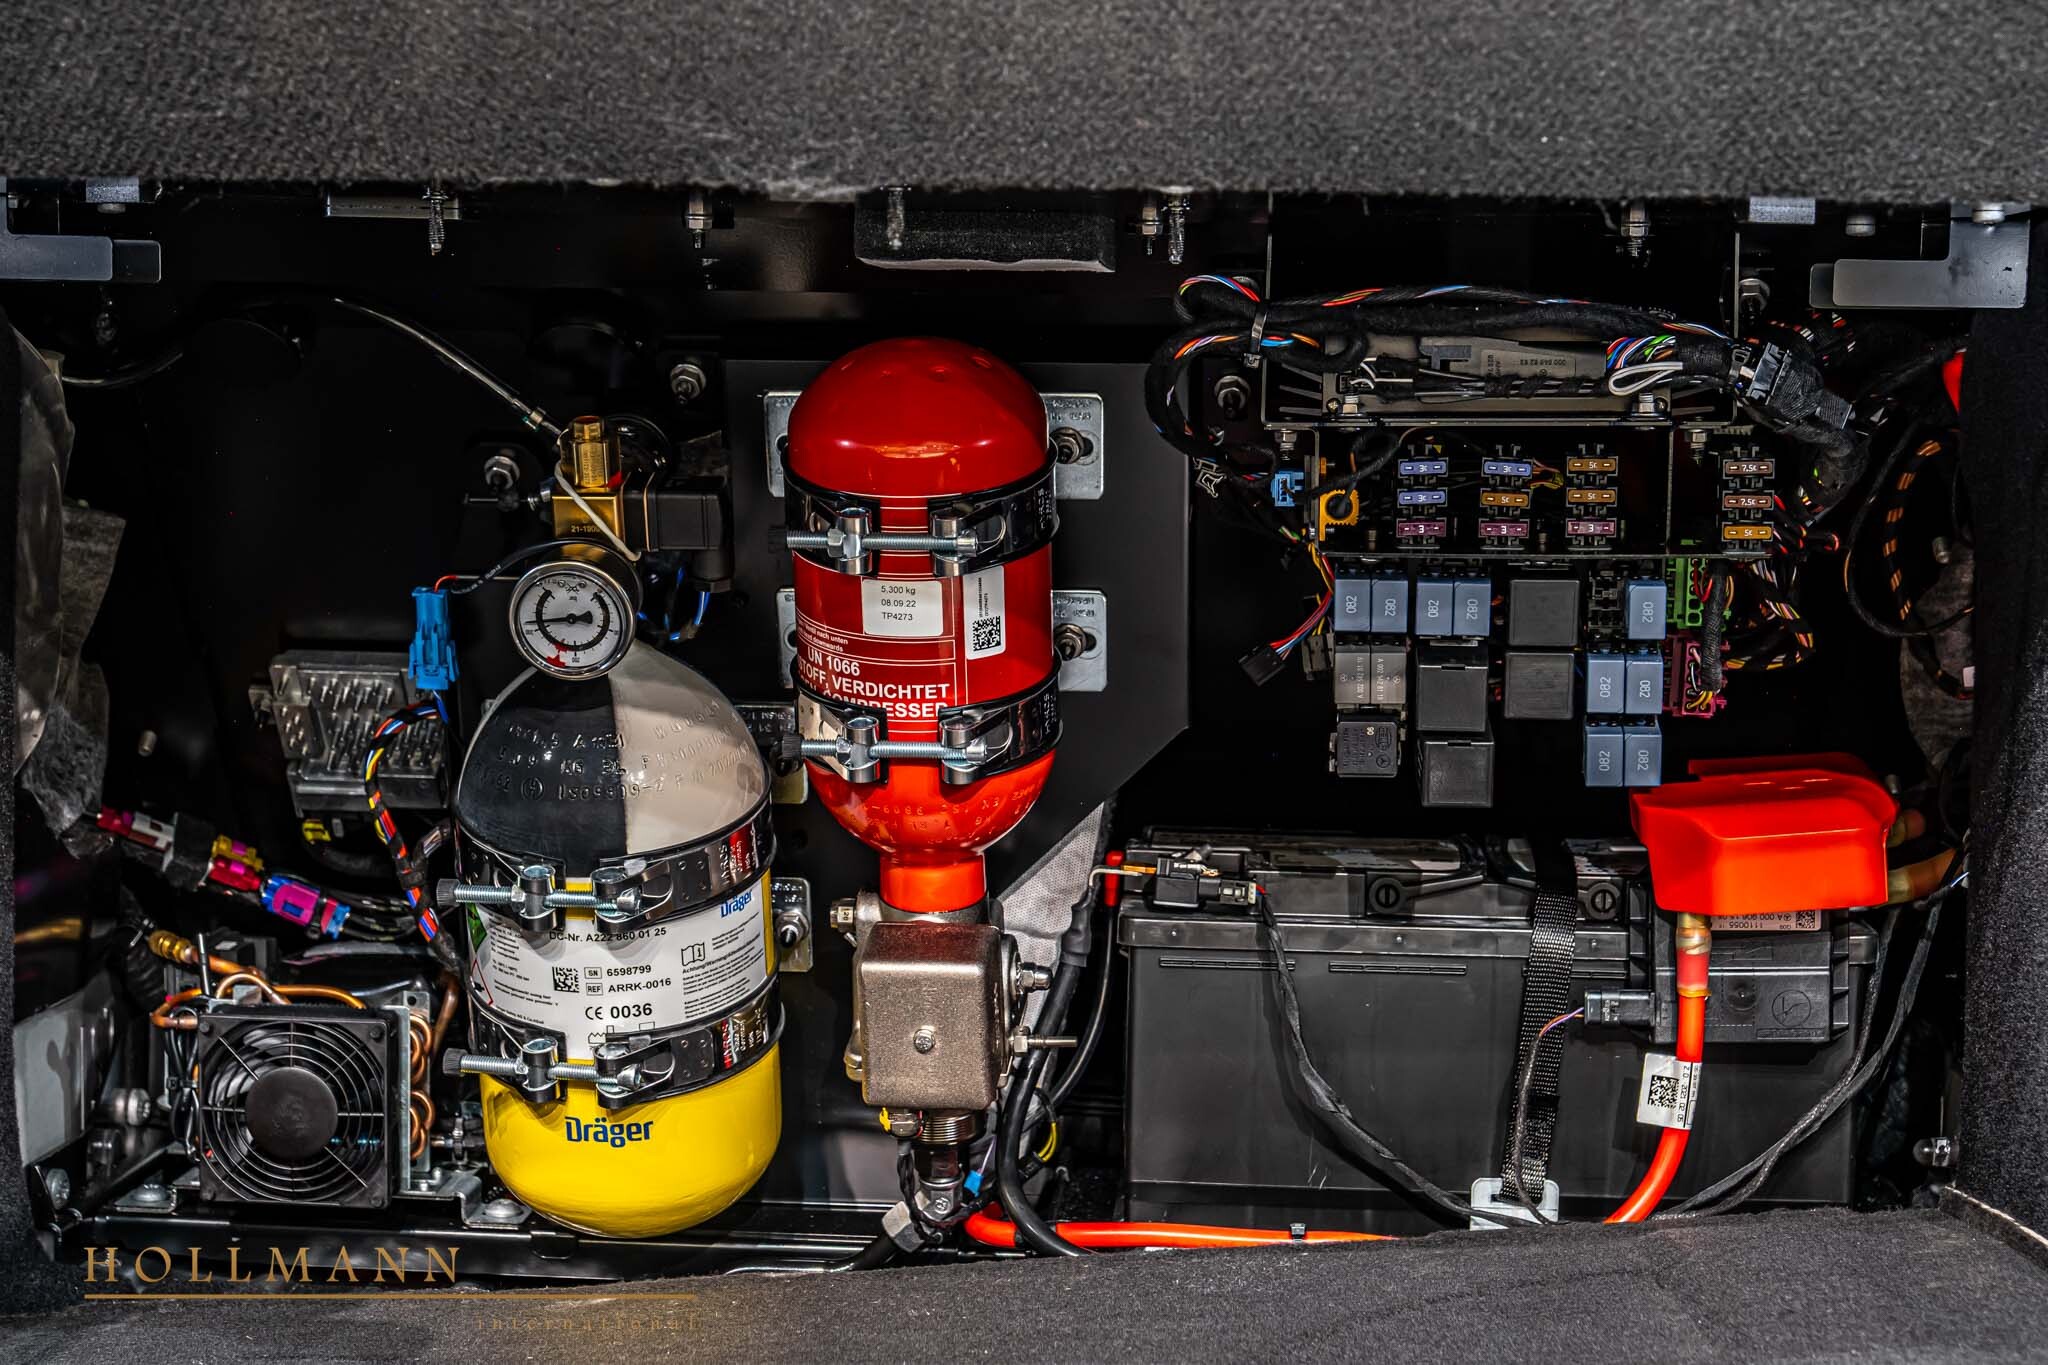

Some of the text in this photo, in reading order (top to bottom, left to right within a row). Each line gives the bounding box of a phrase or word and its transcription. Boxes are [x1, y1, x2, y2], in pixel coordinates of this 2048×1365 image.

[1418, 525, 1425, 534] 3
[1501, 526, 1507, 534] 3
[1588, 524, 1594, 532] 3
[905, 586, 916, 595] kg
[881, 599, 916, 607] 08.09.22
[1346, 595, 1357, 614] 082
[1385, 599, 1396, 616] 082
[1428, 600, 1439, 617] 082
[1466, 599, 1478, 620] 082
[882, 611, 913, 621] TP4273
[1642, 601, 1654, 623] 082
[830, 634, 849, 645] unten
[807, 646, 861, 676] UN 1066
[831, 674, 950, 700] VERDICHTET
[1600, 676, 1611, 698] 082
[1639, 679, 1651, 698] 082
[1599, 750, 1611, 772] 082
[1637, 750, 1649, 771] 082
[549, 927, 667, 942] DC-Nr. A222 860 01 25
[606, 964, 652, 977] 6598799
[588, 978, 672, 993] REF ARRK-0016
[610, 1002, 653, 1019] 0036
[565, 1116, 654, 1148] Dräger
